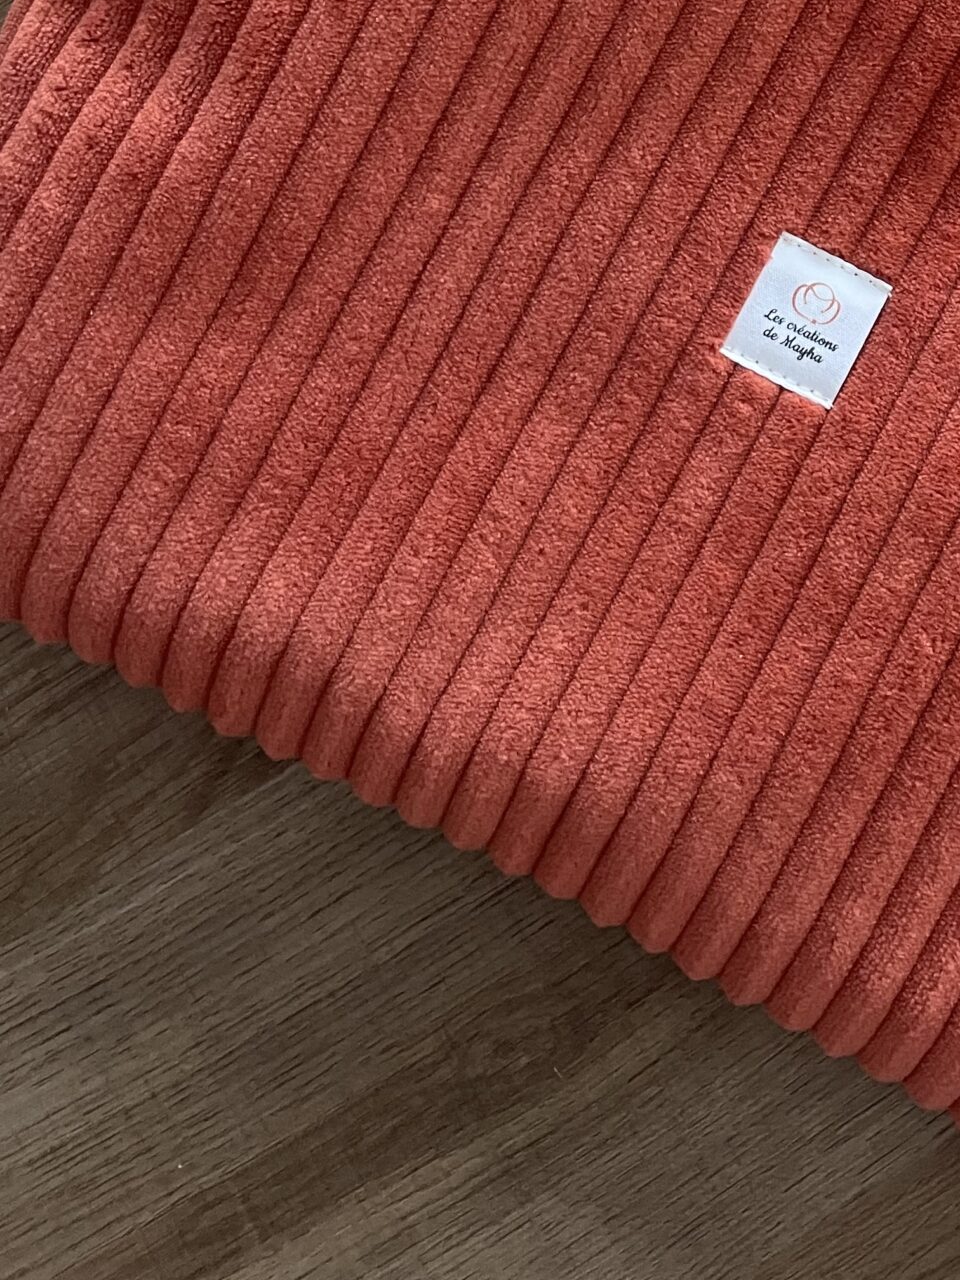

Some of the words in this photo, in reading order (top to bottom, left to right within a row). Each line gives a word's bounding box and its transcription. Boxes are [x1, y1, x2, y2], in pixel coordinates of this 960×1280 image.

[763, 326, 778, 341] de
[780, 335, 823, 363] Mayha
[764, 308, 786, 325] Les
[786, 323, 839, 352] créations
